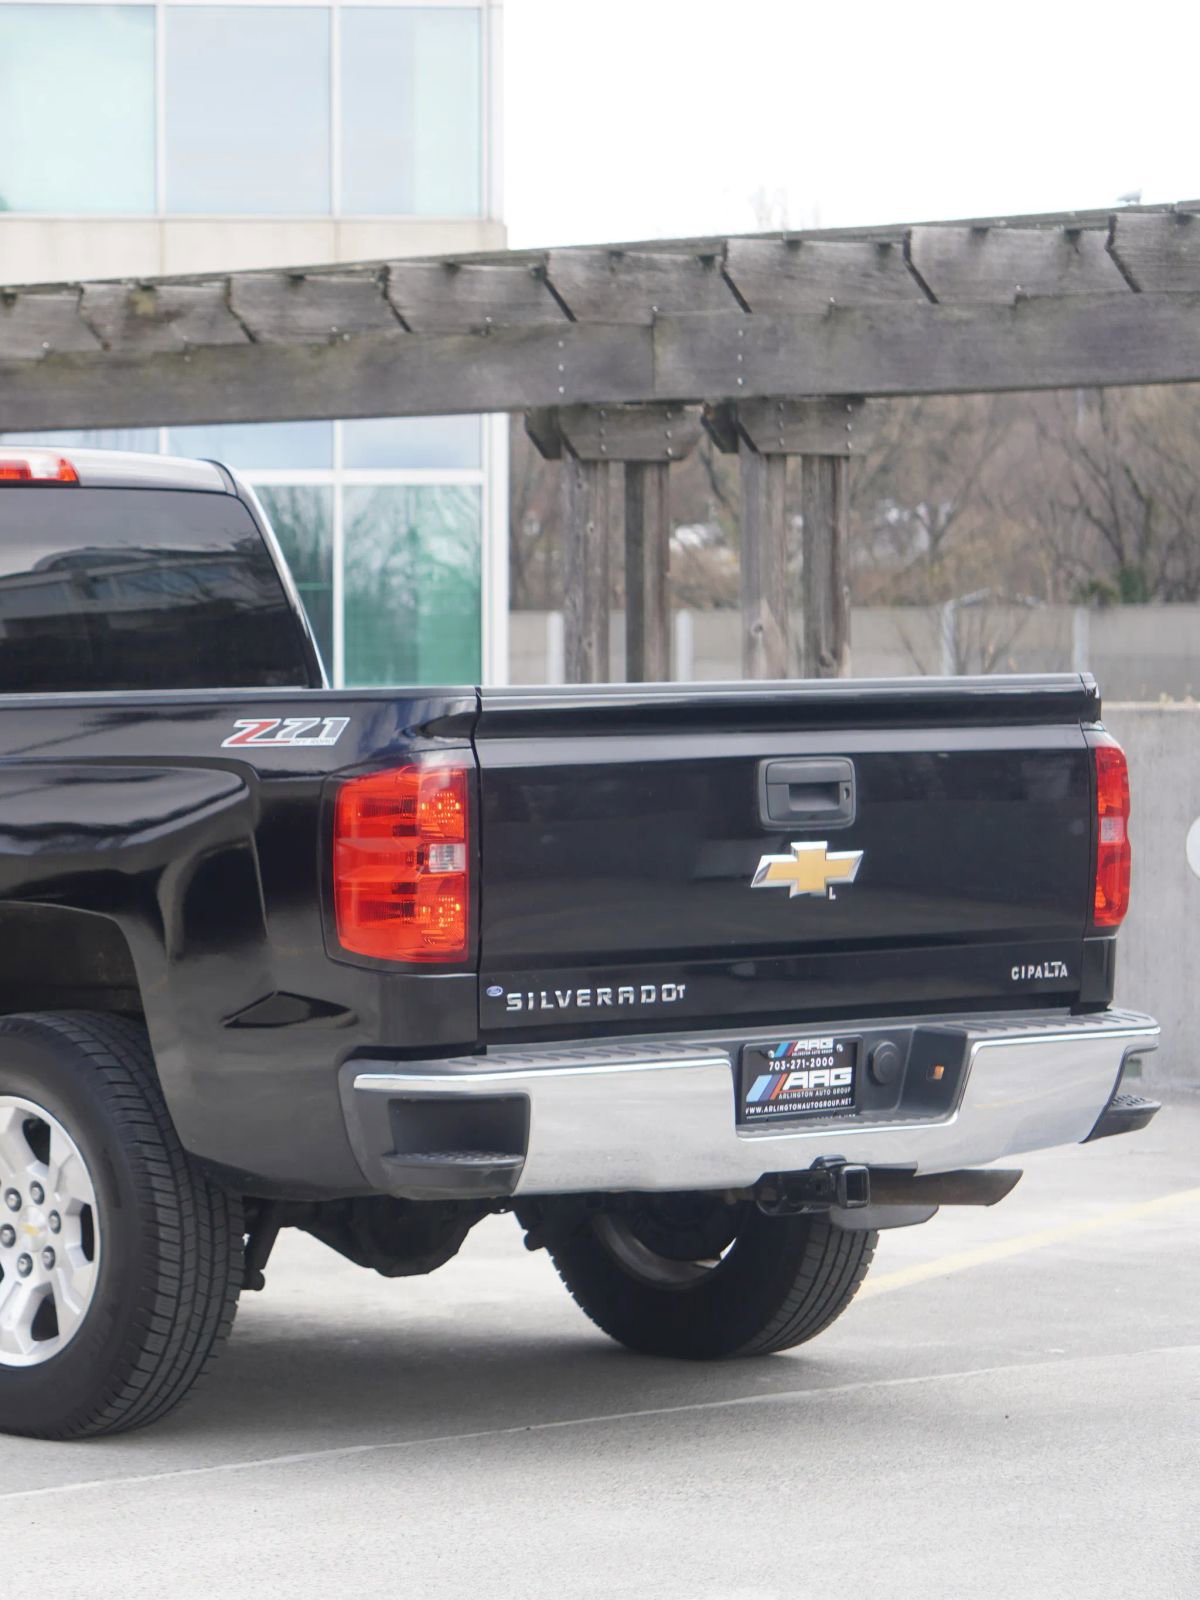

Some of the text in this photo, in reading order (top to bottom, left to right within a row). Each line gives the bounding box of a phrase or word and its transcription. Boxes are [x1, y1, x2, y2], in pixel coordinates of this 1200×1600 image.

[220, 717, 351, 747] Z71
[794, 1037, 834, 1050] AAG
[782, 1067, 853, 1091] AAG
[778, 1087, 851, 1100] ARLINGTON AUTO GROUP
